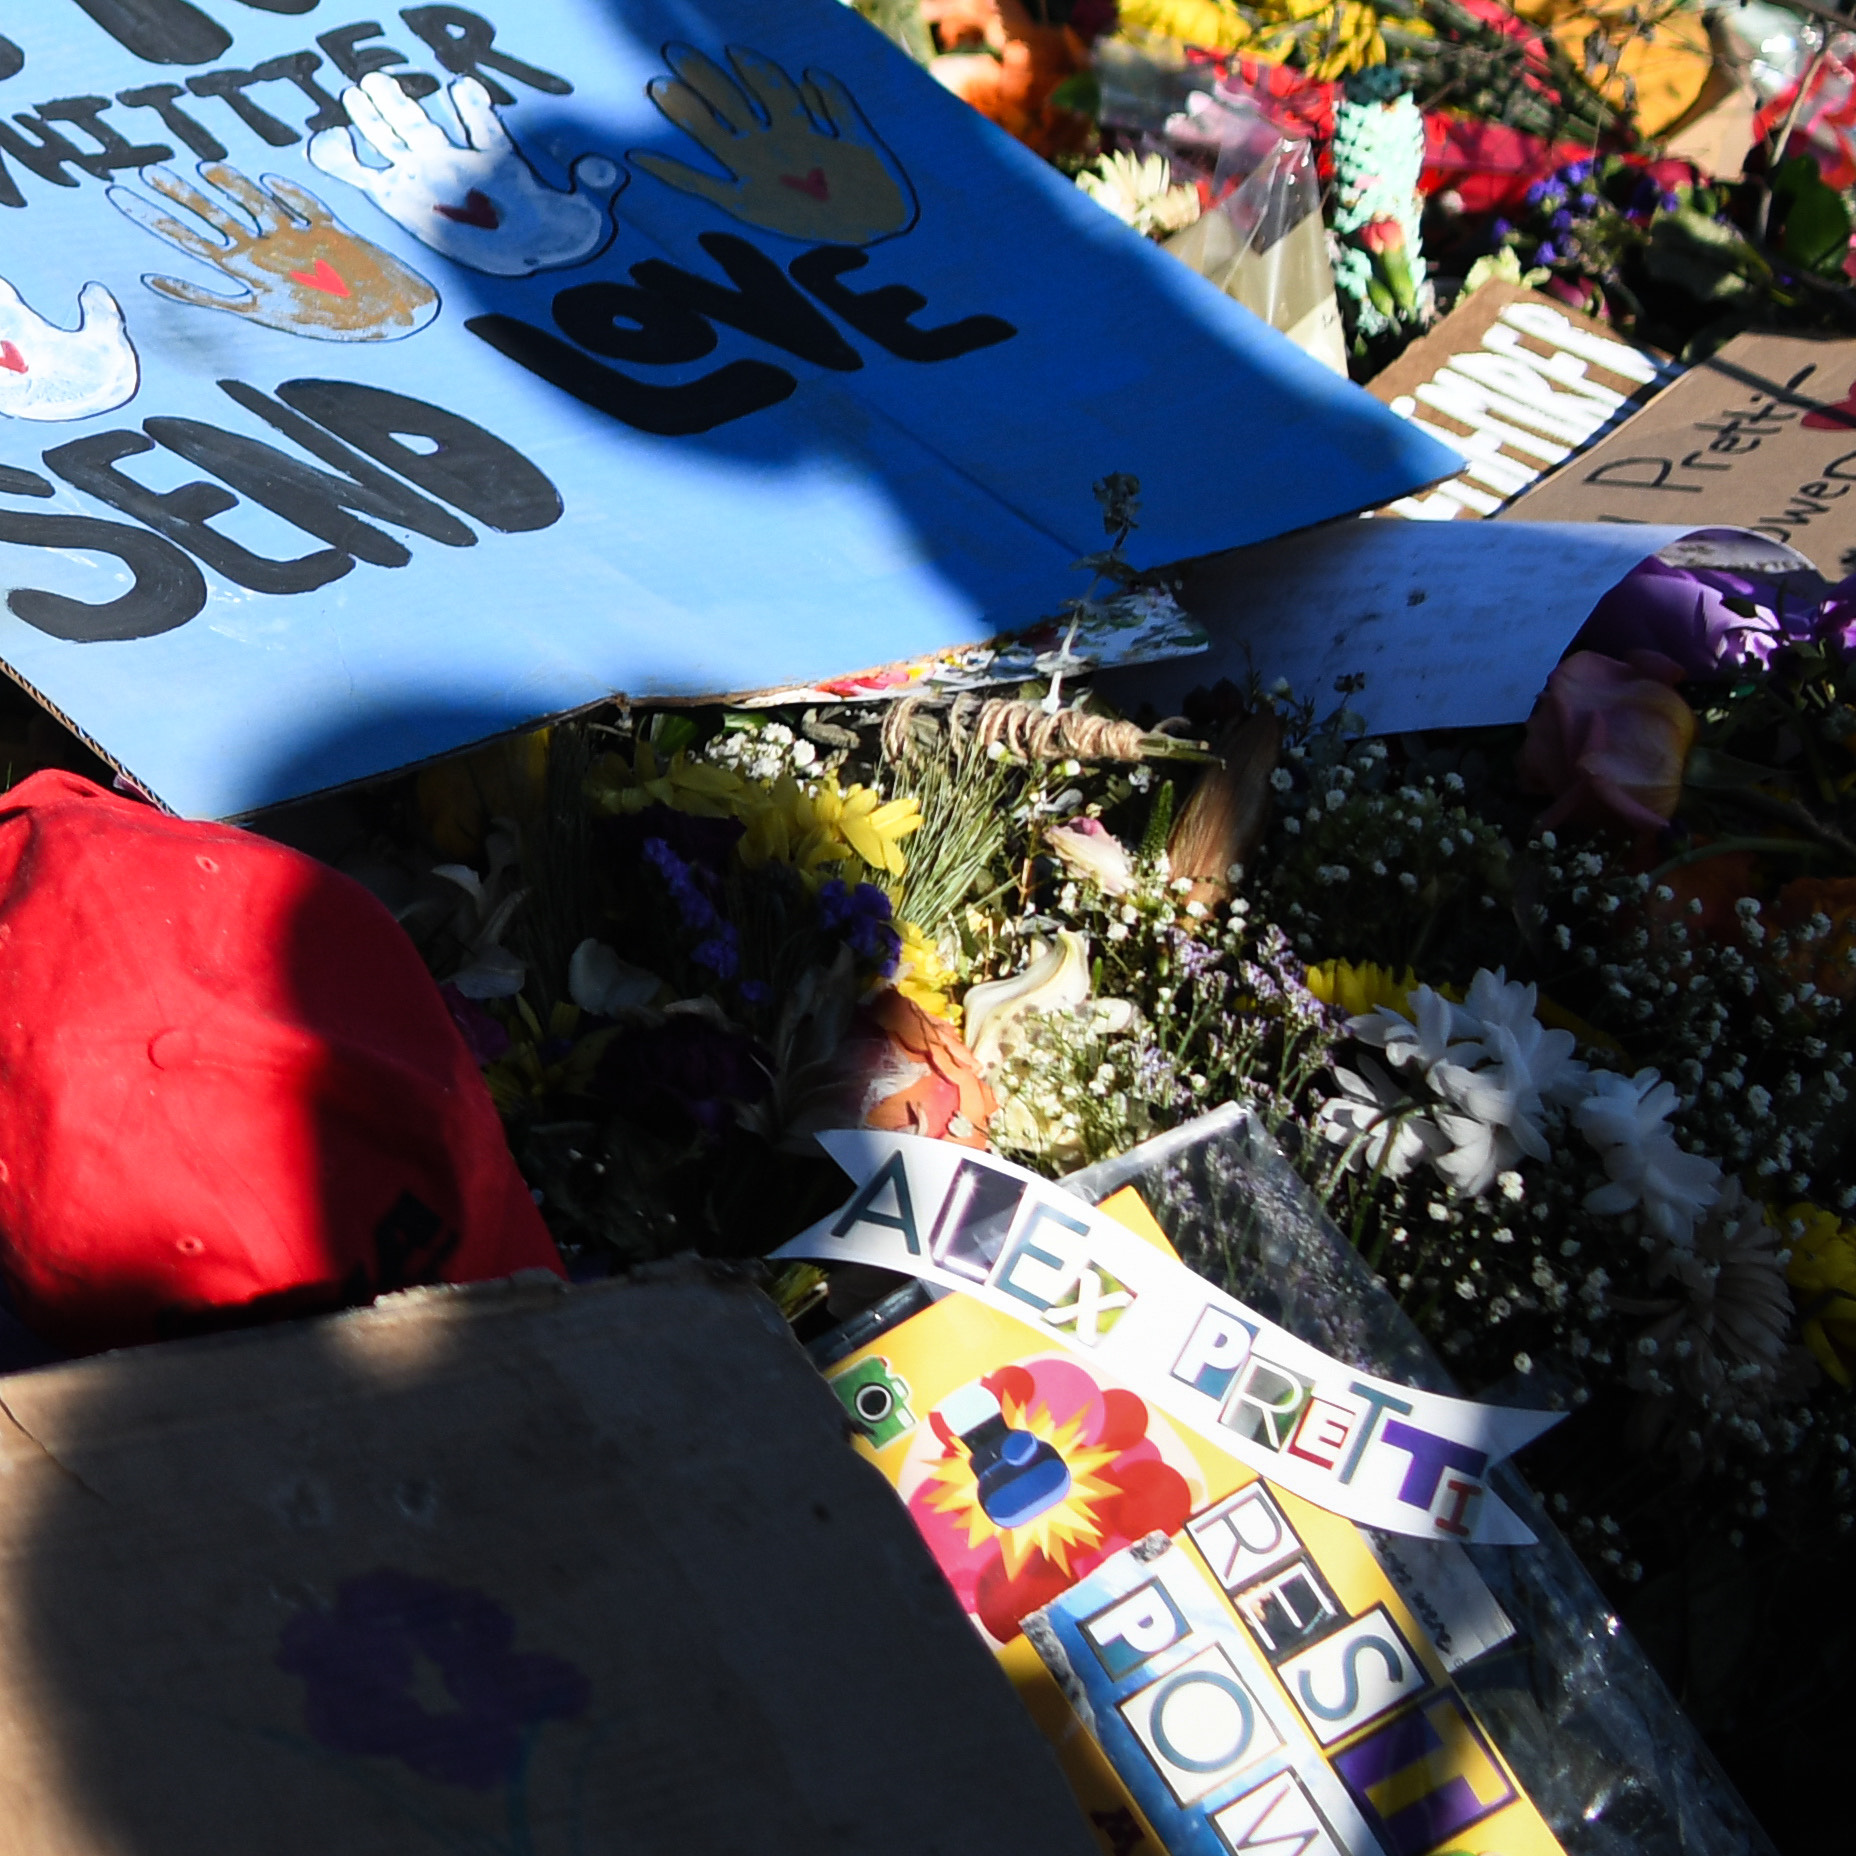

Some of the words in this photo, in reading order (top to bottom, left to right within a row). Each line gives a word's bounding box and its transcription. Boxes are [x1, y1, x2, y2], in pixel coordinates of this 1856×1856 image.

[465, 232, 1018, 437] LOVE
[829, 1148, 1138, 1349] ALEX
[1170, 1301, 1488, 1541] PRETTI
[1193, 1482, 1510, 1824] REST
